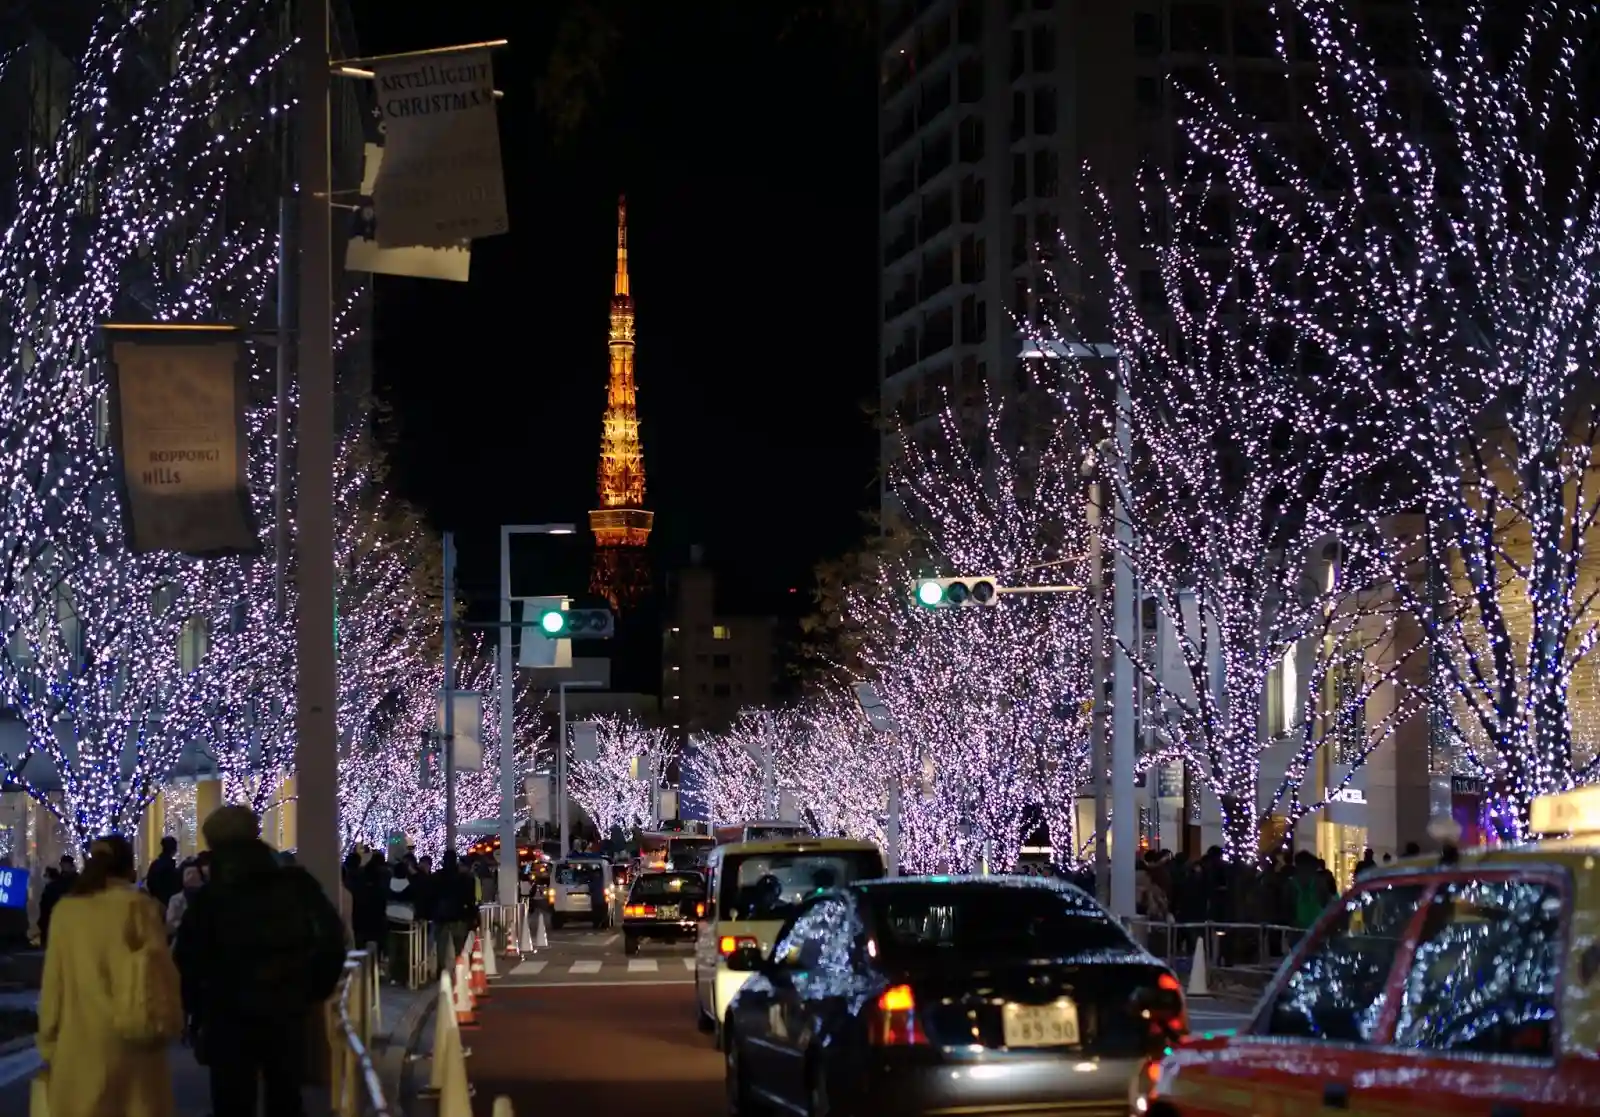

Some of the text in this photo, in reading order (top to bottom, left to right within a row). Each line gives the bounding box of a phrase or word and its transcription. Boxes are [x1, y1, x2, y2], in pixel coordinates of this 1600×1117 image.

[386, 87, 492, 118] CHRISTMAS
[149, 448, 220, 463] ROPPONGI
[142, 466, 181, 485] HILLS
